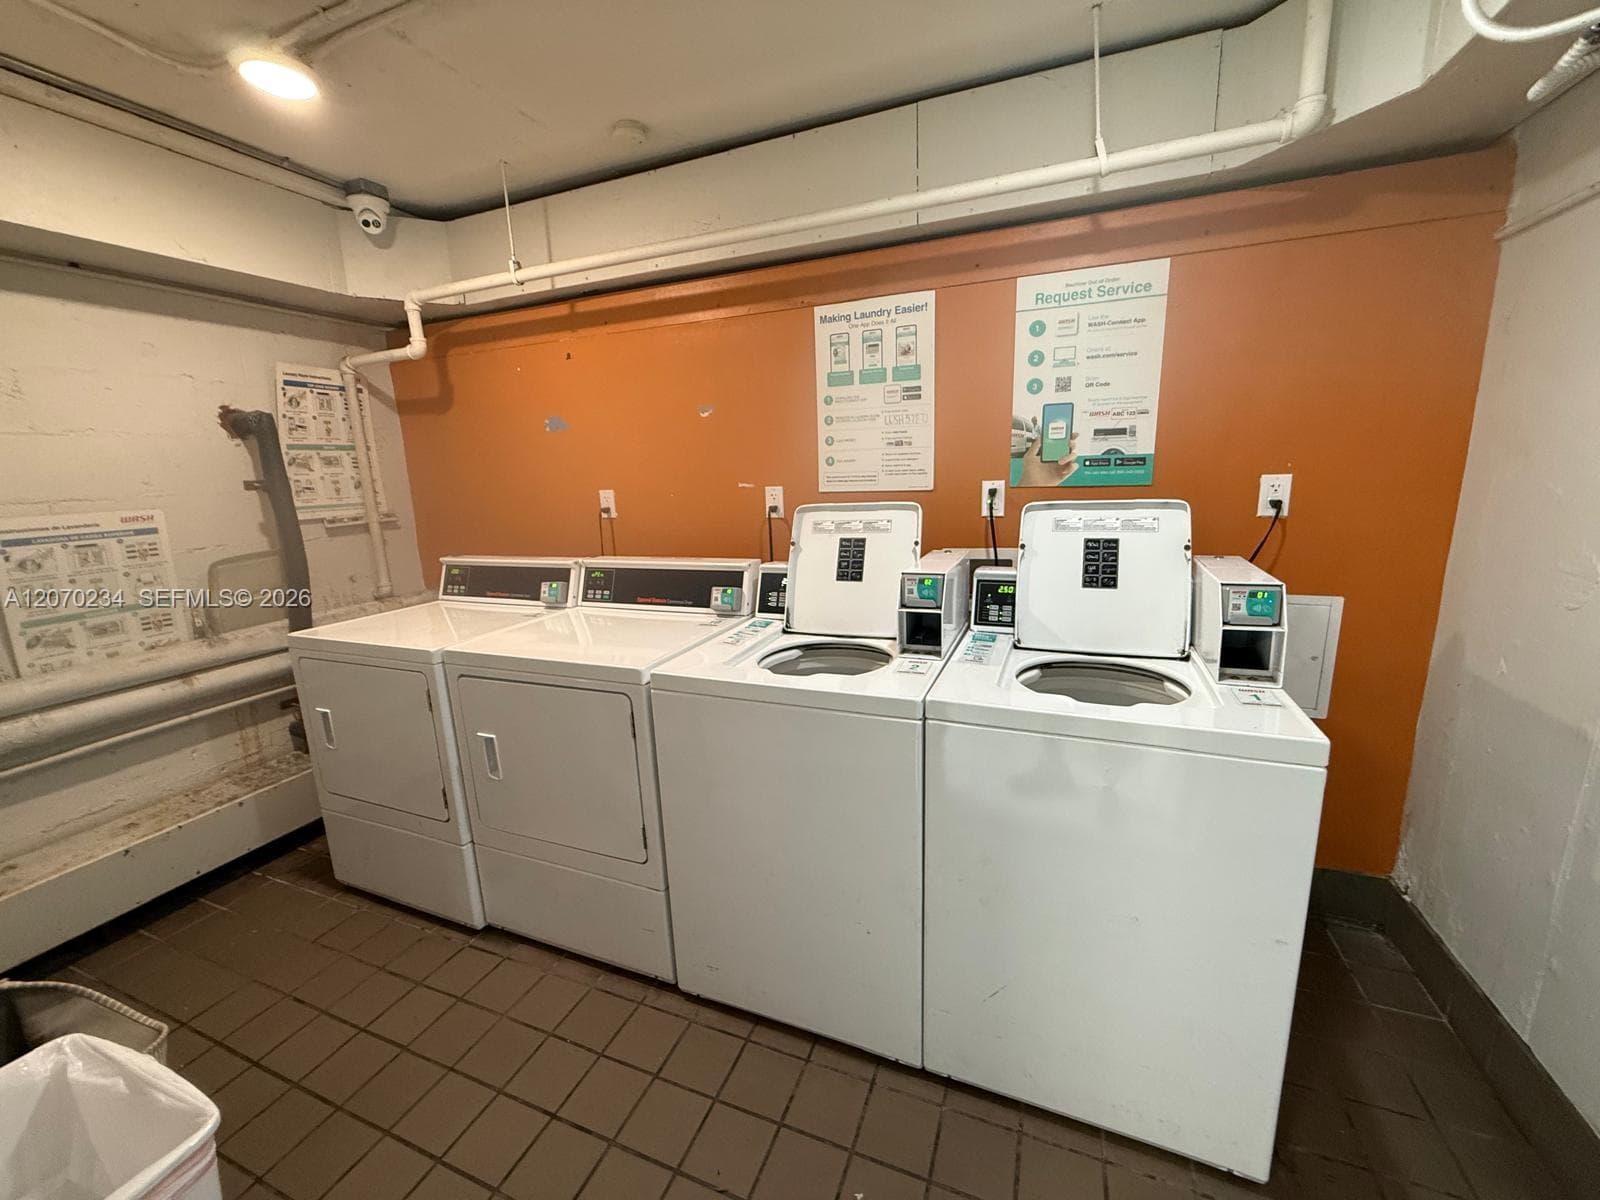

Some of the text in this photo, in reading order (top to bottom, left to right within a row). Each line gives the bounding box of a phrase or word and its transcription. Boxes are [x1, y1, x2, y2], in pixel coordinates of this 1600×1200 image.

[1035, 281, 1152, 305] Request Service
[820, 302, 928, 324] Making Laundry Easier!
[998, 585, 1014, 593] 250
[1257, 591, 1268, 599] 01
